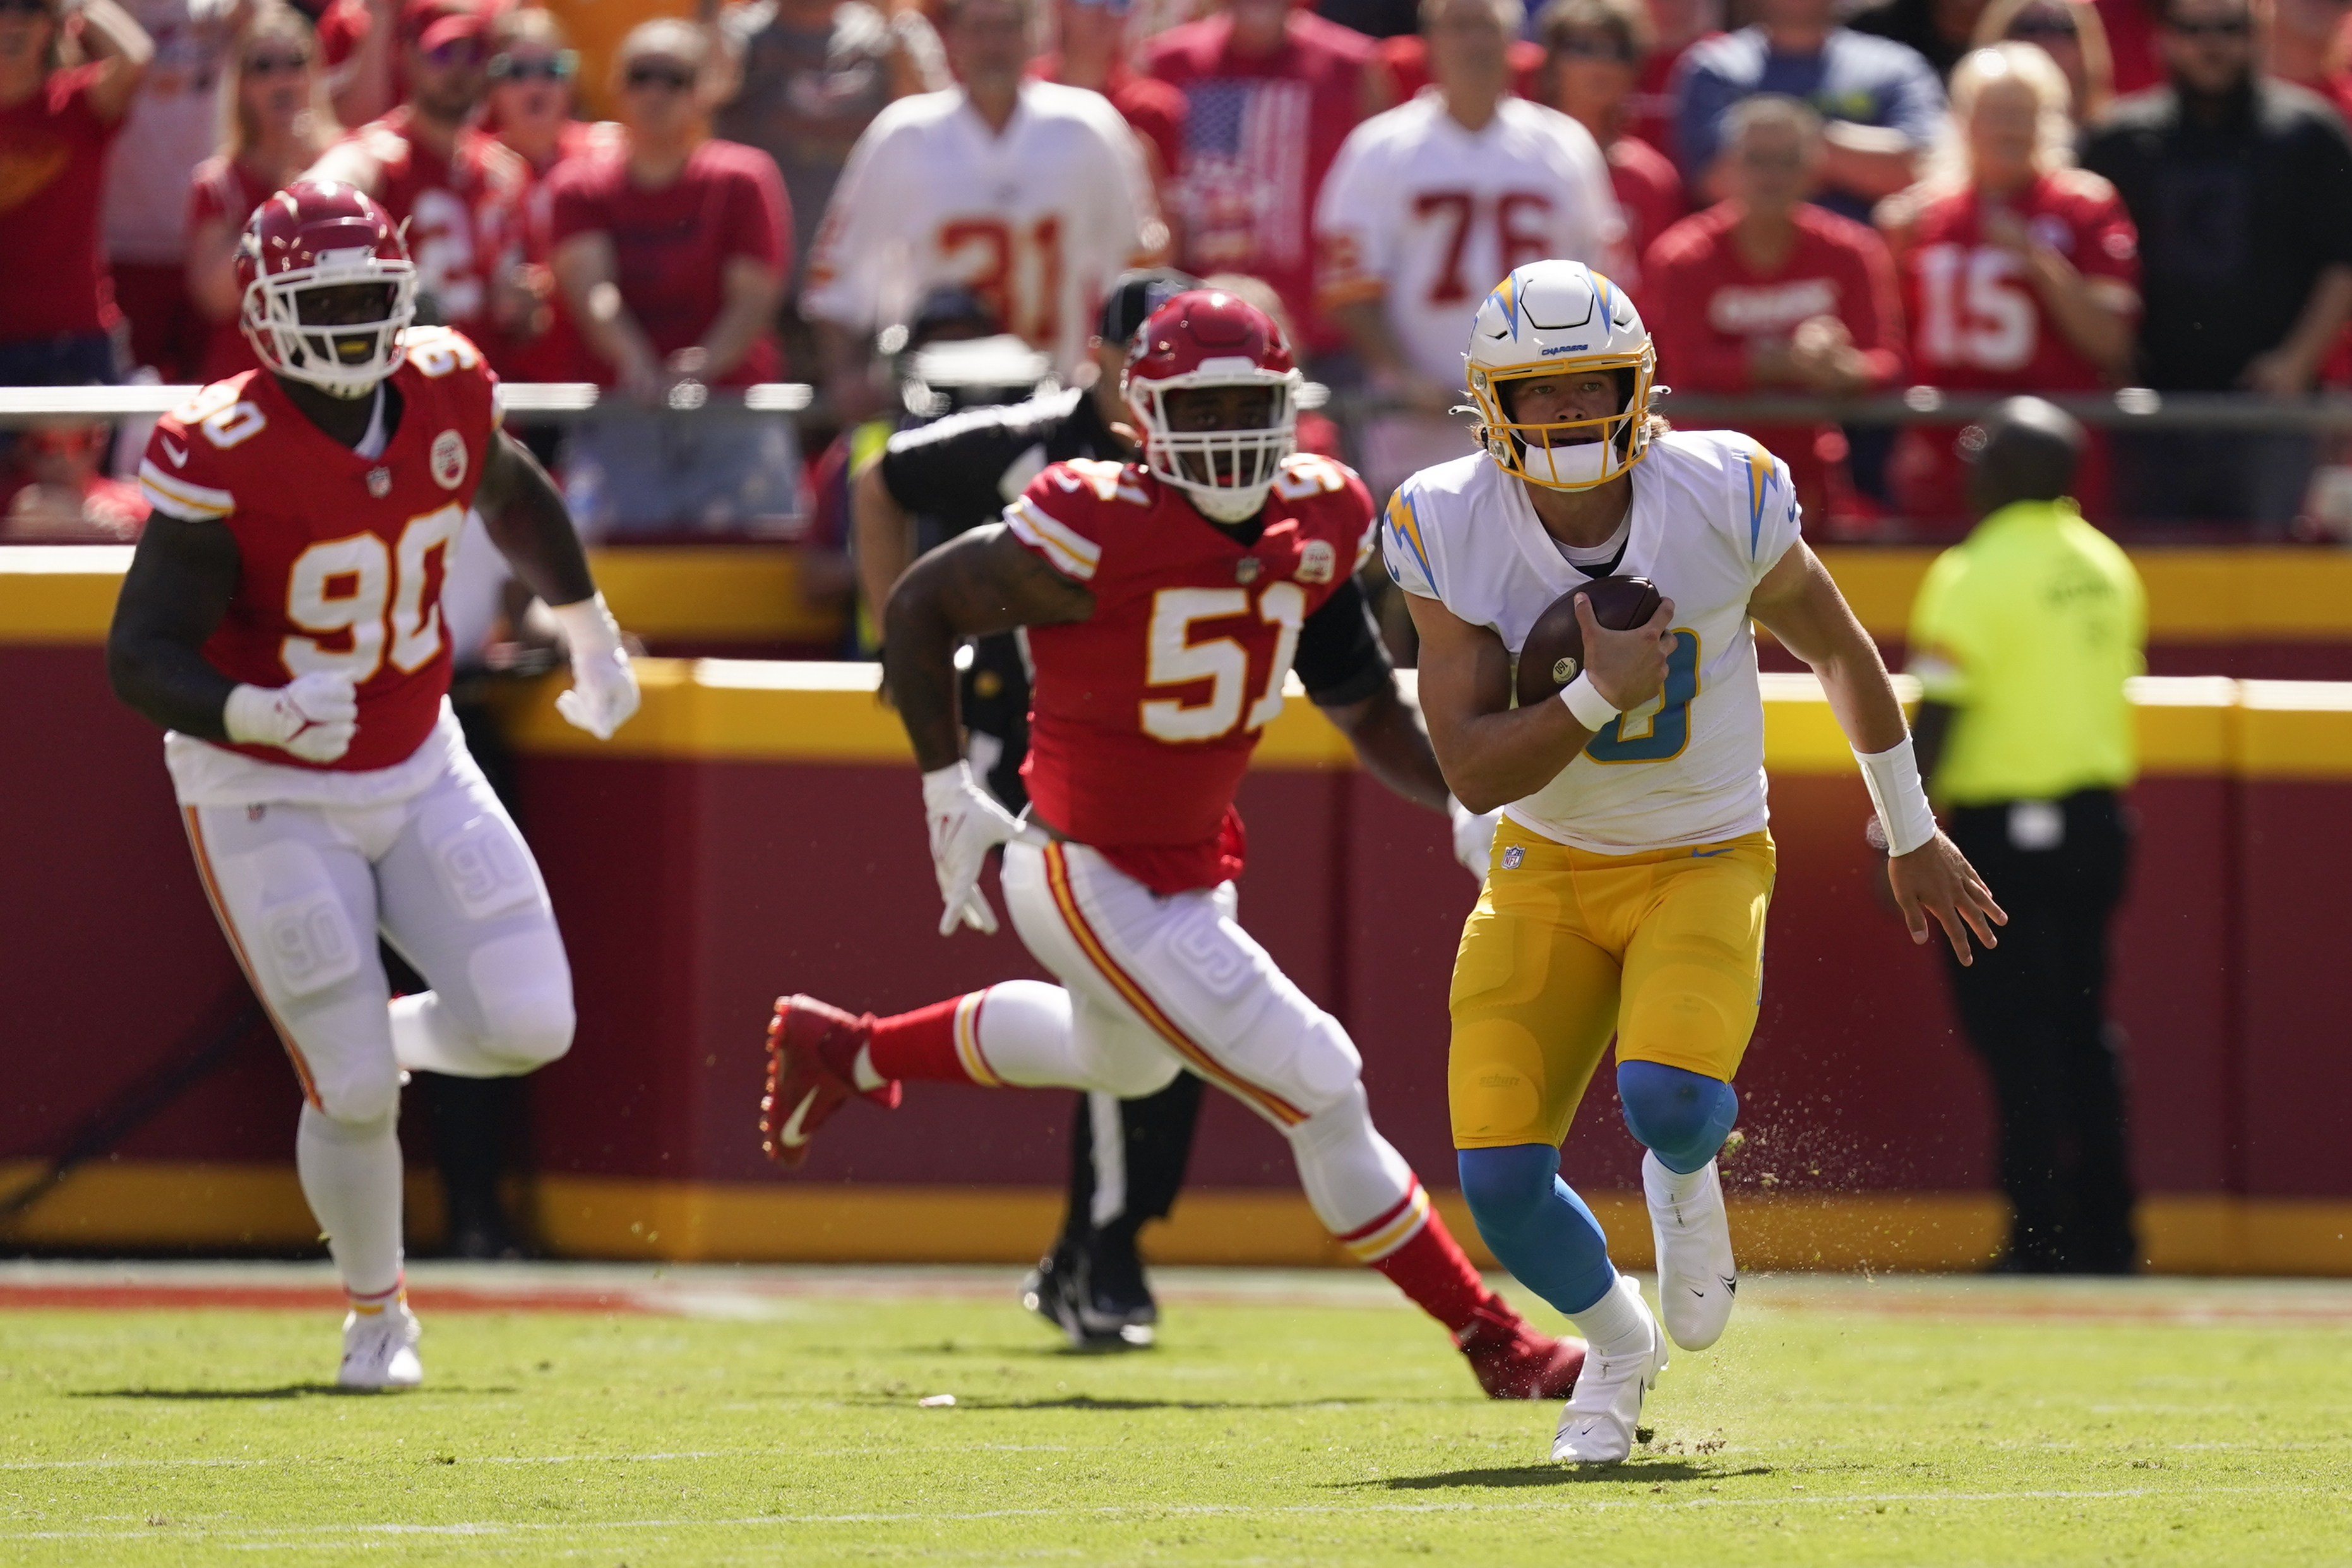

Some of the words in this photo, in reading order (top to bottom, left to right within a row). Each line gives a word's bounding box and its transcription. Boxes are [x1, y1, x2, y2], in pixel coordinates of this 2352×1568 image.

[1922, 244, 2037, 367] 15
[1541, 344, 1589, 355] CHARGERS
[278, 498, 467, 684] 90
[1139, 580, 1307, 744] 51
[1555, 660, 1568, 675] 160
[1504, 856, 1519, 865] NFL
